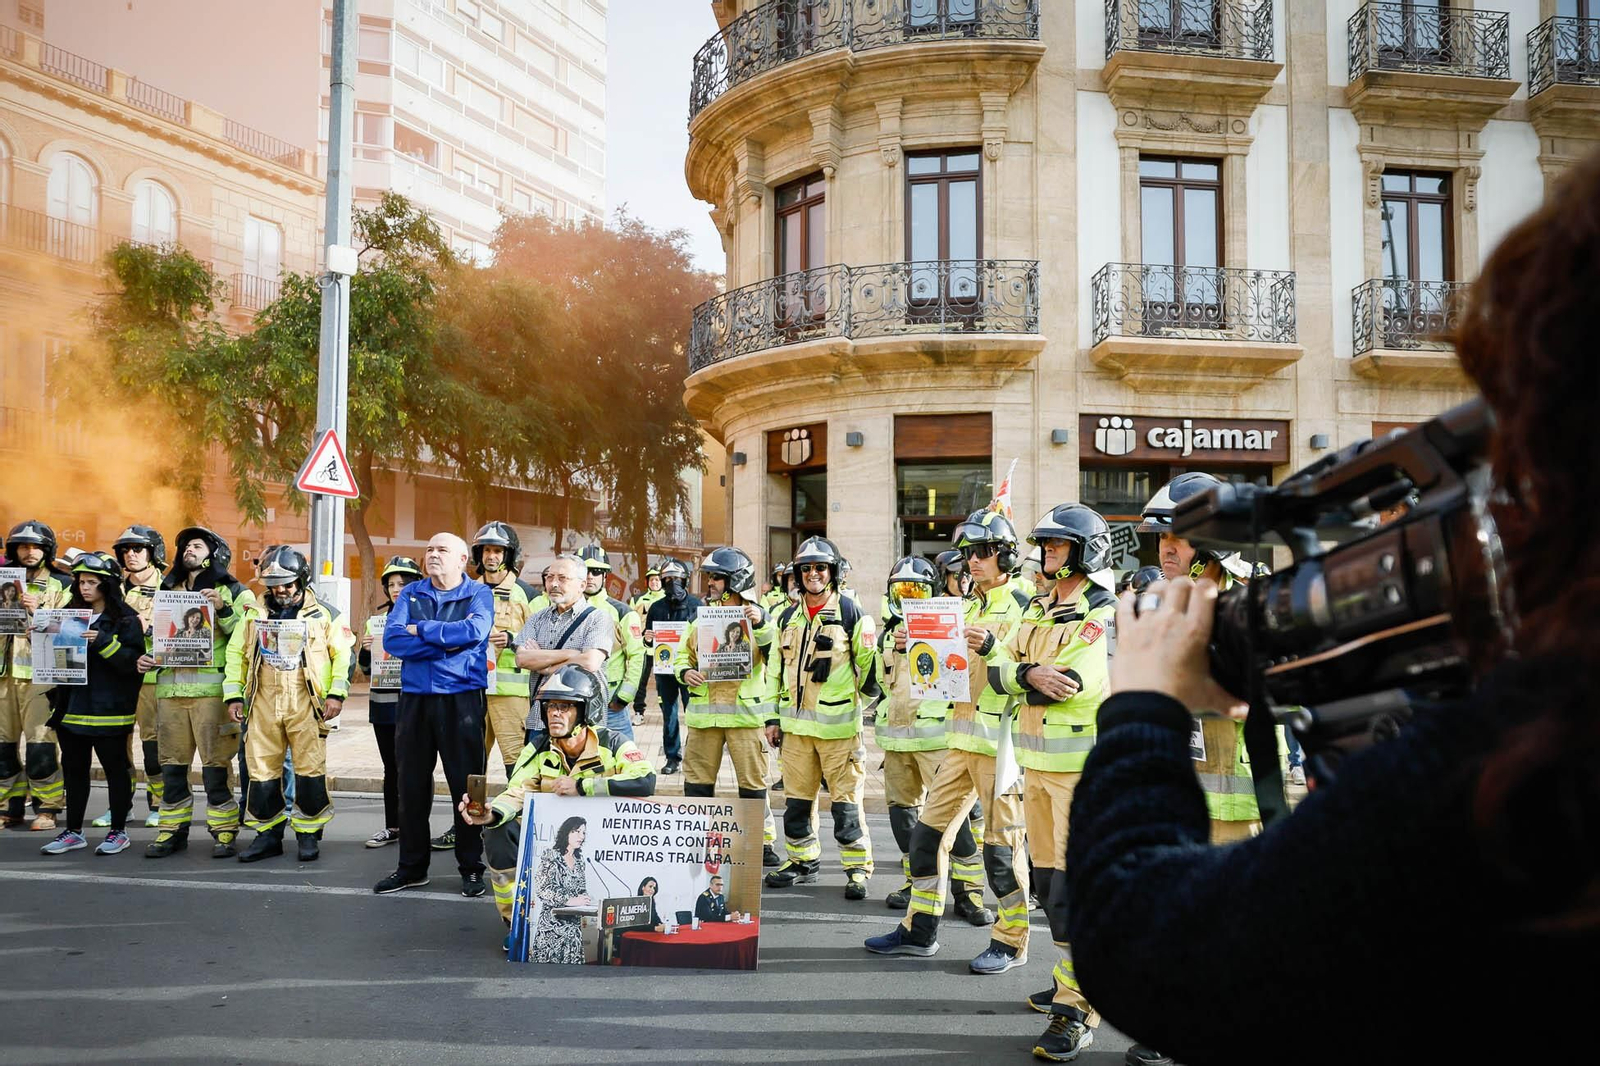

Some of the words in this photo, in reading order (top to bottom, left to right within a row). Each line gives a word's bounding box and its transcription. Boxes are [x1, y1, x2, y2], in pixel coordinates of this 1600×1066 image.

[1147, 419, 1279, 457] cajamar
[615, 802, 661, 815] VAMOS
[665, 804, 674, 815] A
[678, 804, 733, 816] CONTAR
[602, 818, 671, 831] MENTIRAS
[675, 820, 743, 835] TRALARA,
[612, 834, 659, 847] VAMOS
[662, 836, 671, 847] A
[675, 836, 731, 849] CONTAR
[595, 850, 664, 863] MENTIRAS
[668, 852, 745, 866] TRALARA...
[620, 902, 647, 915] ALMERÍA
